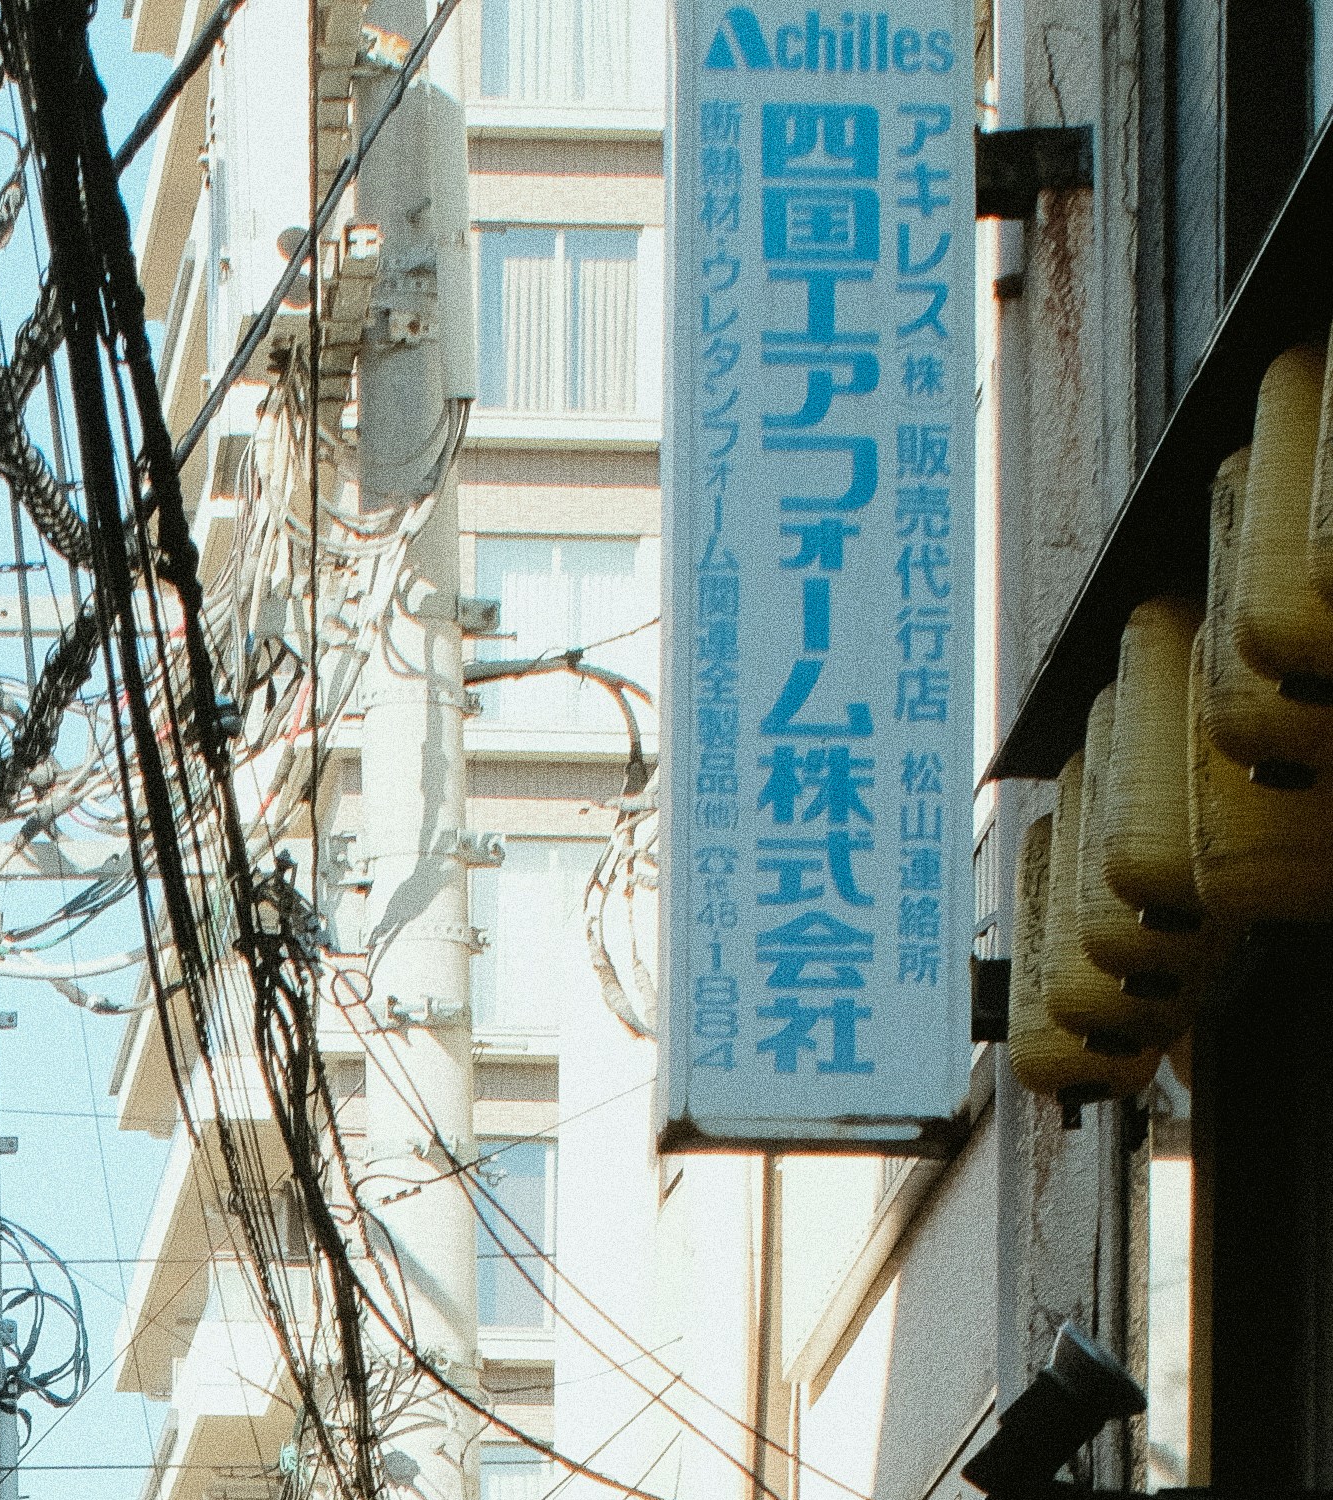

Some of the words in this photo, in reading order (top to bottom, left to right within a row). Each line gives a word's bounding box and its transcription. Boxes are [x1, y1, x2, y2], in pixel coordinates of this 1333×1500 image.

[701, 6, 955, 73] Achilles
[757, 102, 879, 1073] 四国エアフォーム株式会社
